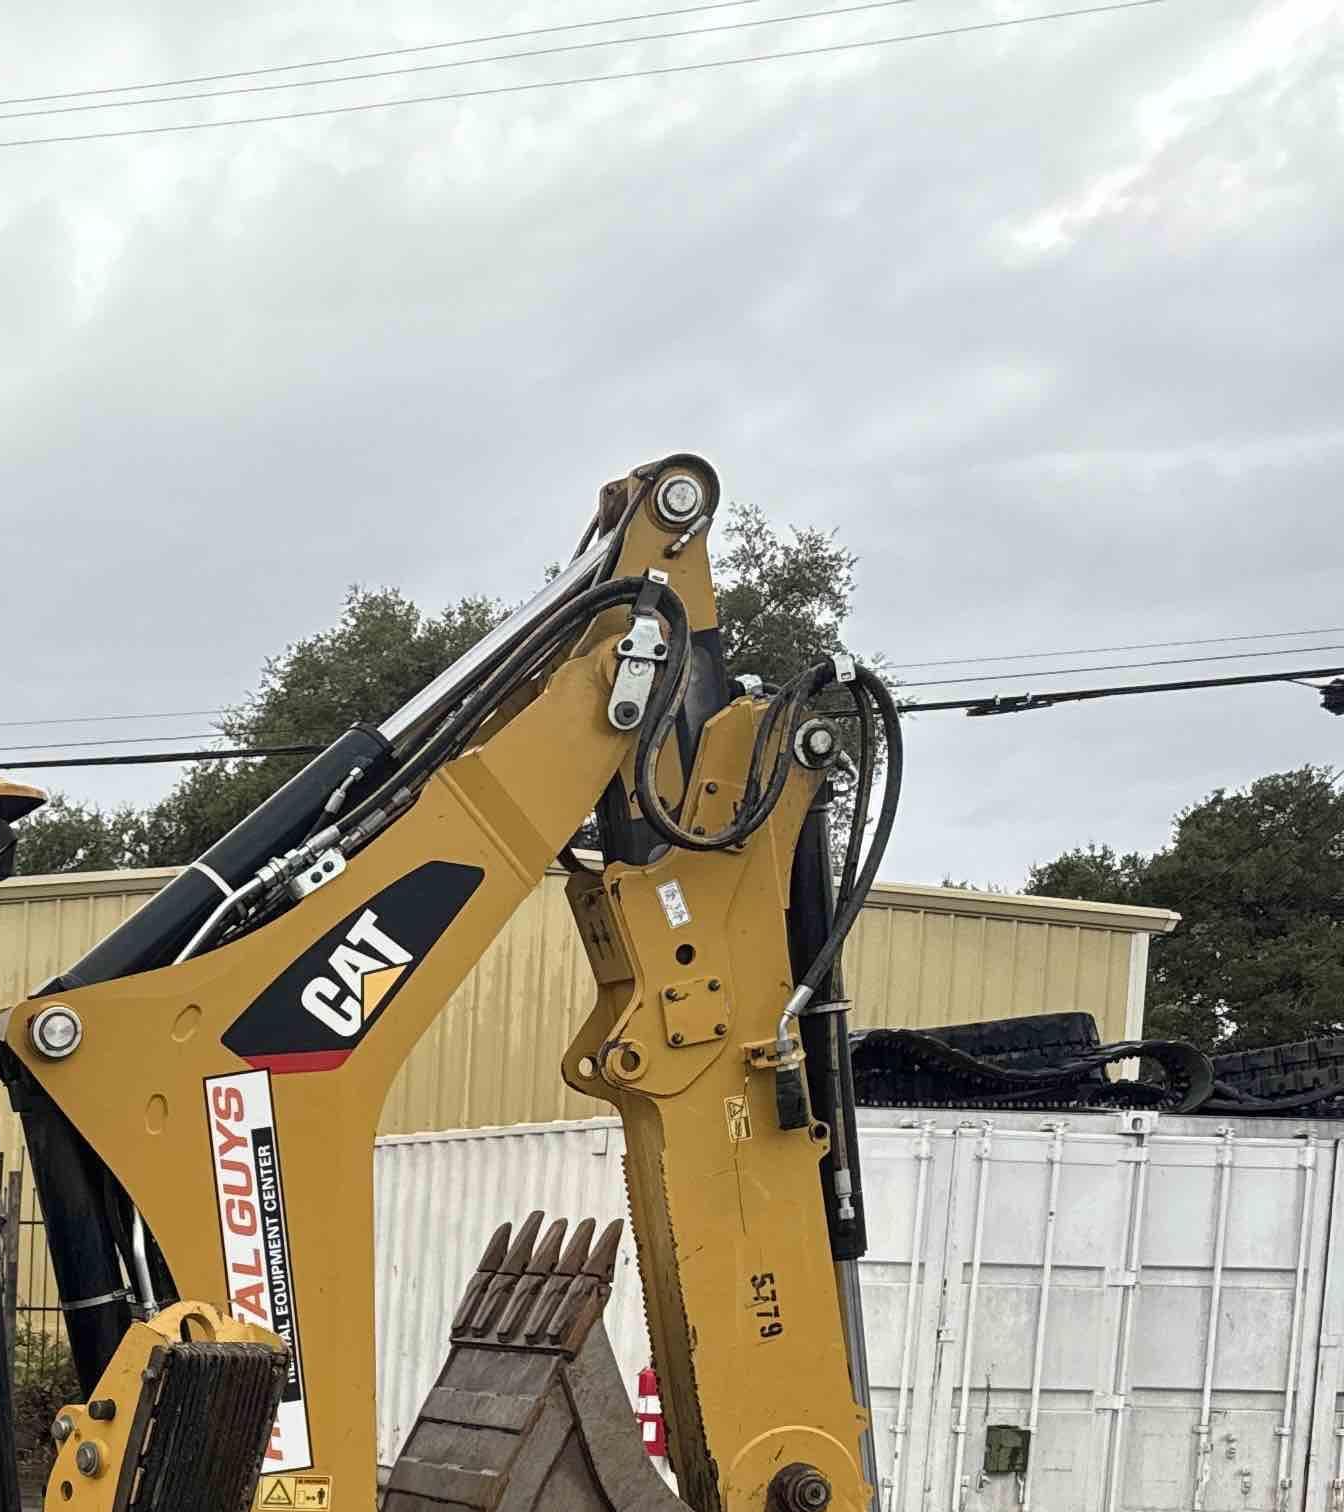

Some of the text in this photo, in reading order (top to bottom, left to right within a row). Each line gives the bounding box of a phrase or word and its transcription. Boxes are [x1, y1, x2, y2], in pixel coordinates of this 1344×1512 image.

[301, 908, 413, 1037] CAT
[212, 1086, 258, 1237] GUYS
[257, 1145, 277, 1212] CENTER
[265, 1217, 288, 1320] EQUIPMENT
